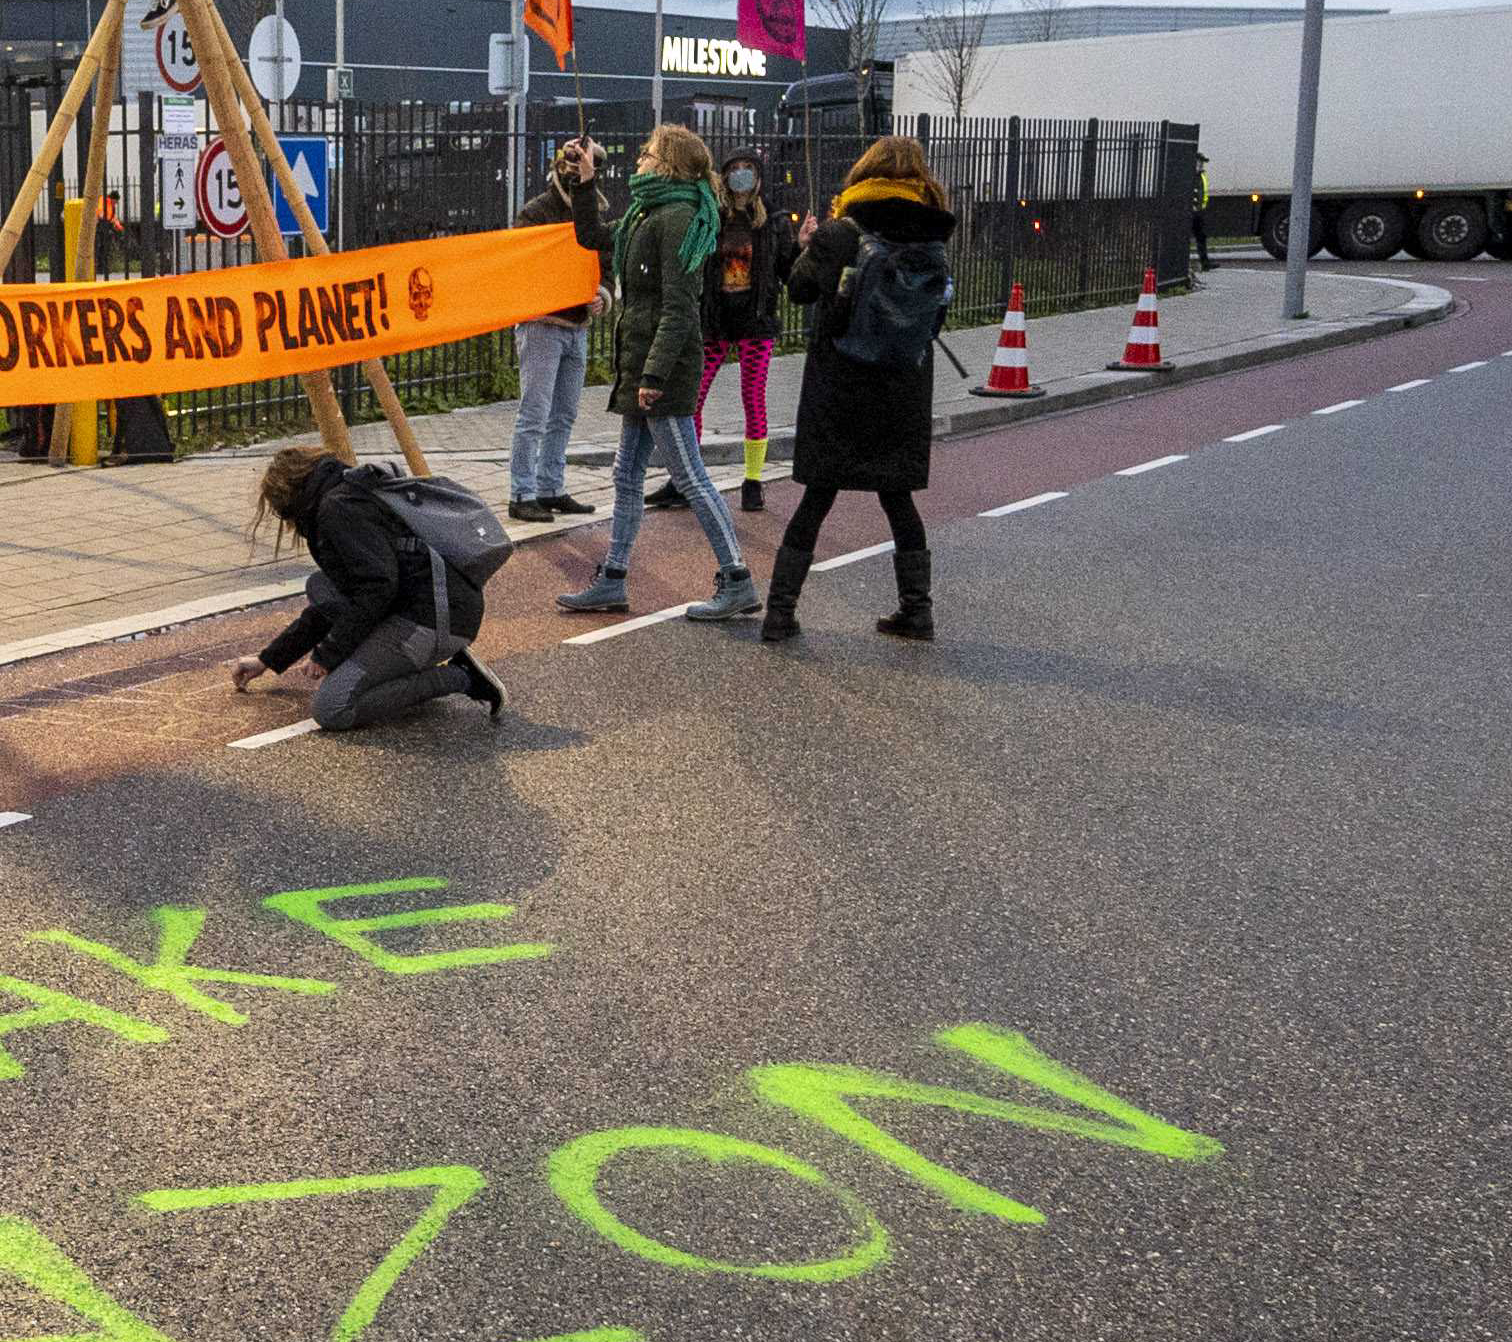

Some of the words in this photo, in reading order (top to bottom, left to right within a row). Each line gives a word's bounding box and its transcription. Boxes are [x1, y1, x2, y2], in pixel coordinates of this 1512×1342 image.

[167, 30, 196, 66] 15
[661, 36, 767, 77] MILESTONE
[158, 135, 198, 150] HERAS
[215, 168, 243, 210] 15
[164, 295, 243, 361] AND
[253, 272, 391, 354] PLANET!
